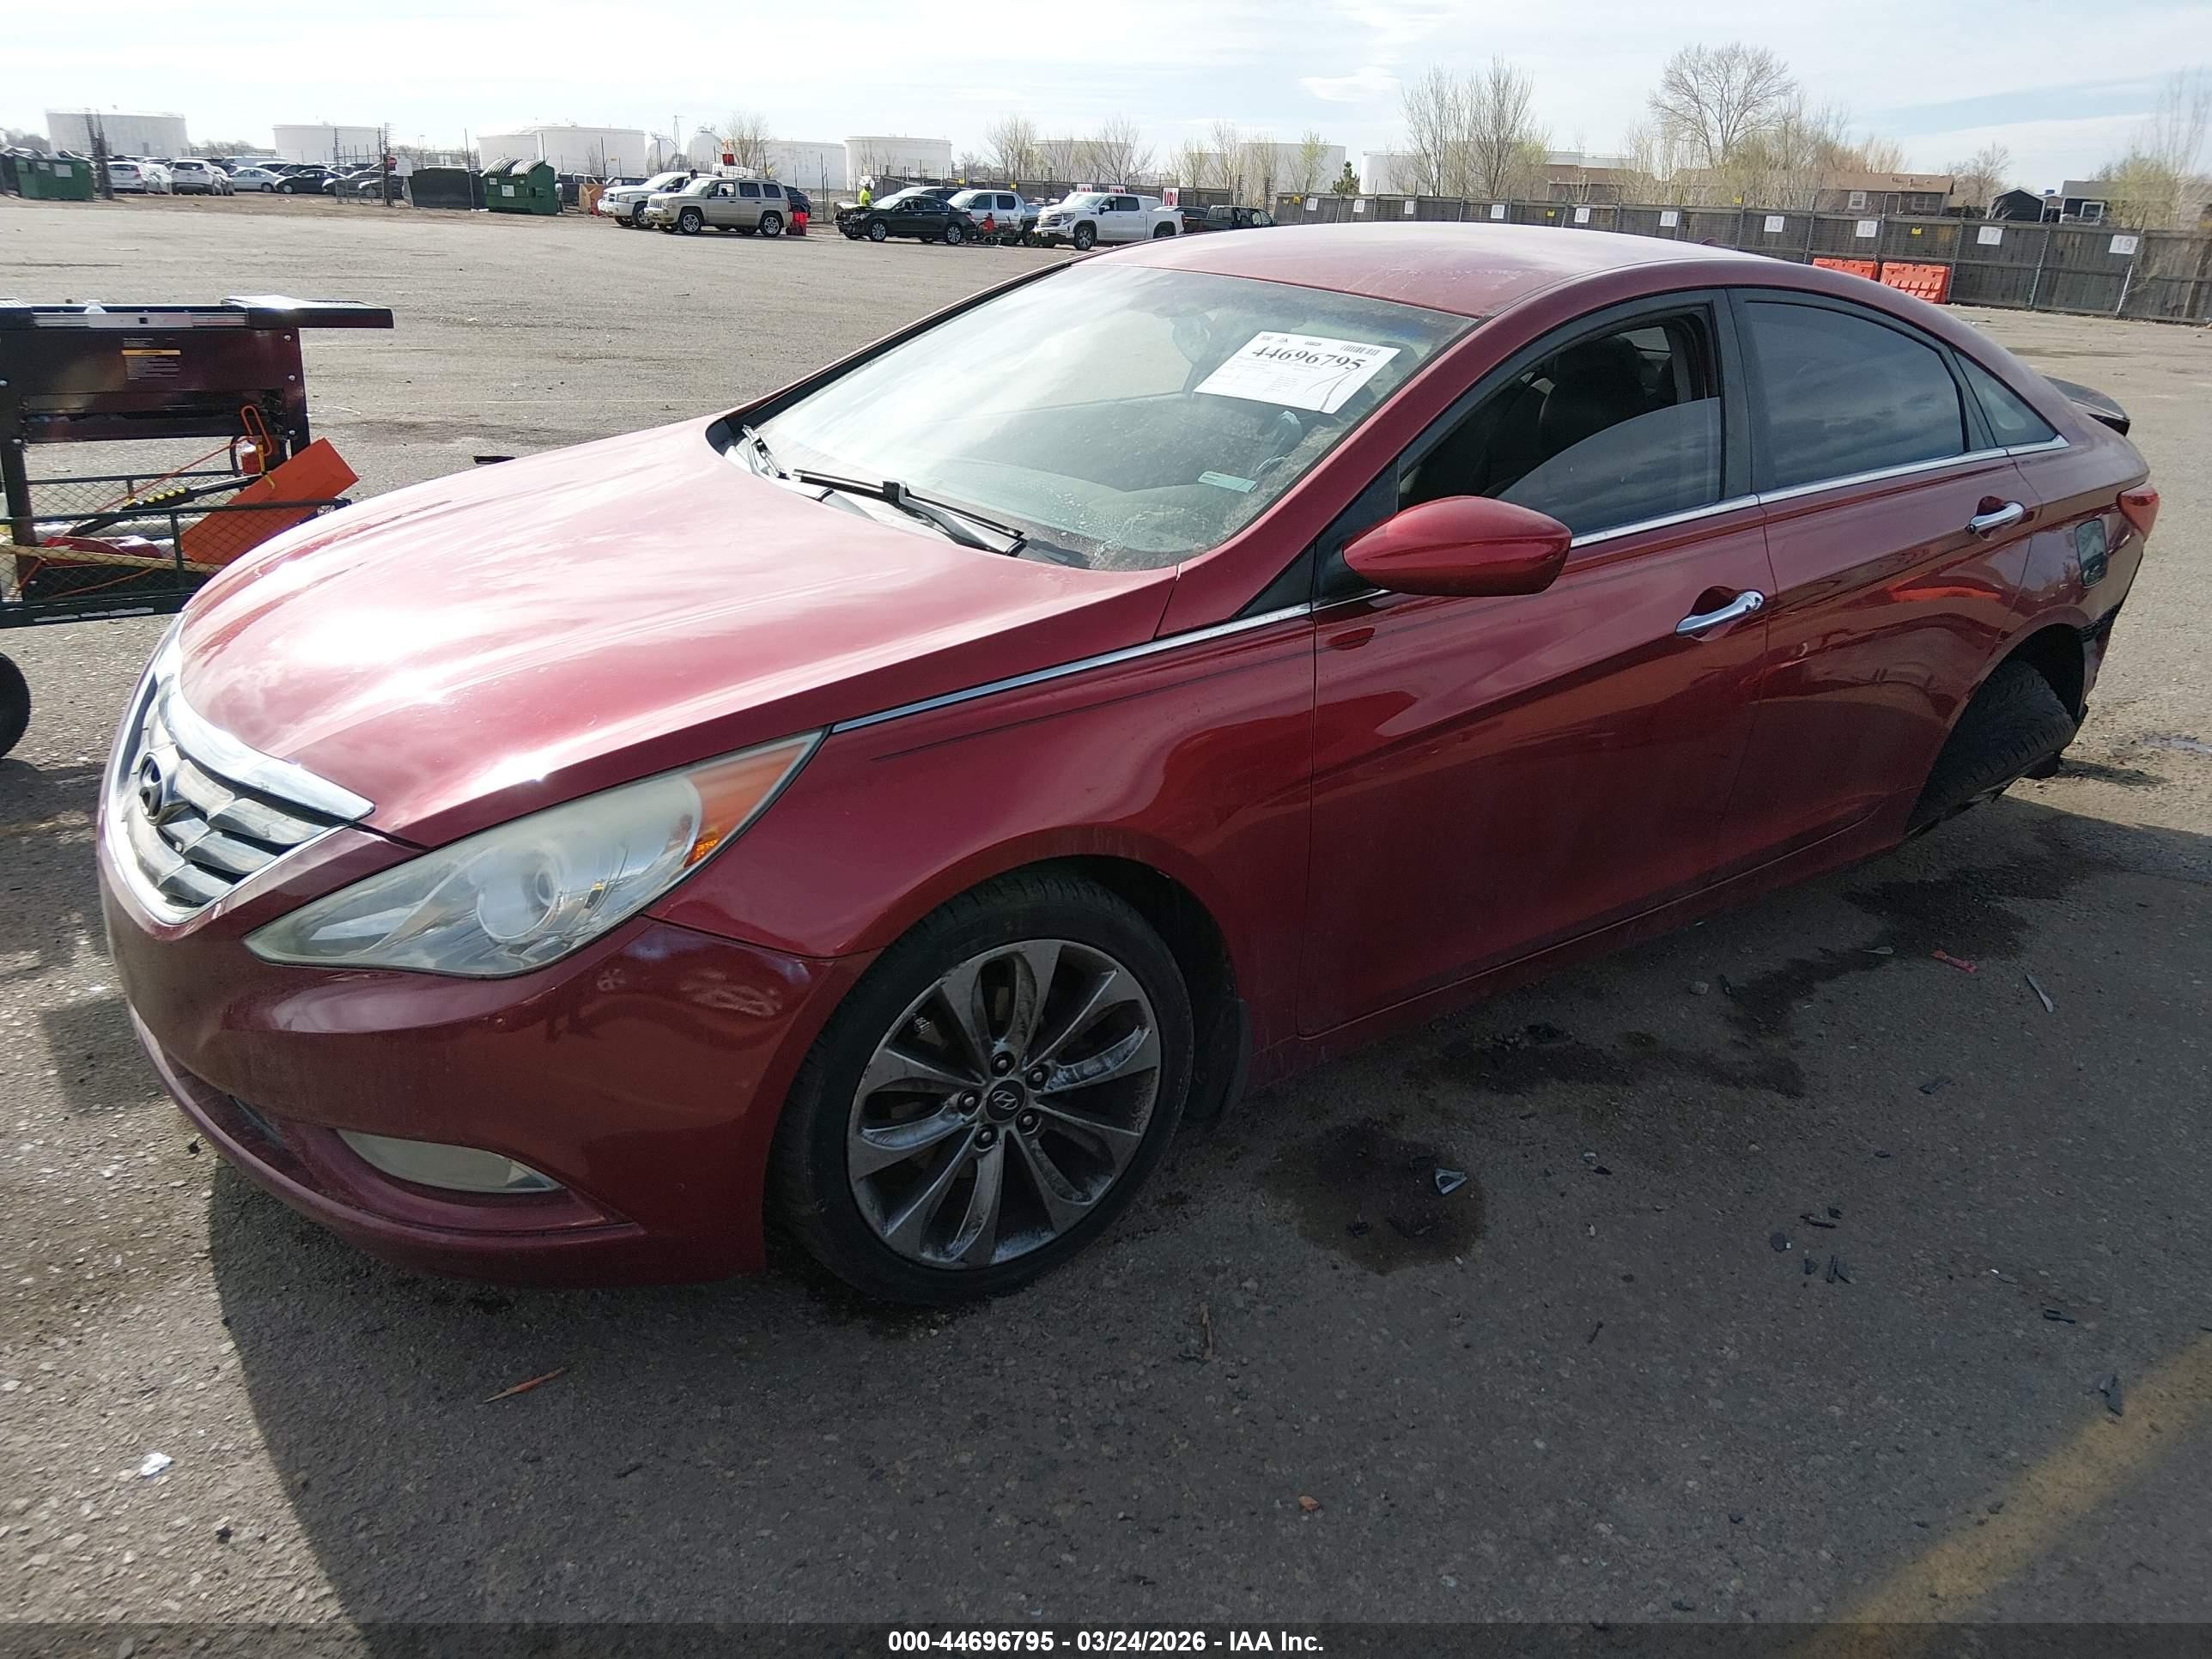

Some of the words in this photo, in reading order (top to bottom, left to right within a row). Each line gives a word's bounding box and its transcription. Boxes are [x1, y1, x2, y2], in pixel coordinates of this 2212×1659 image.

[1769, 218, 1780, 229] 13
[1861, 223, 1875, 234] 15
[1984, 229, 1999, 241] 17
[2116, 239, 2132, 251] 19
[1252, 346, 1367, 371] 44696795
